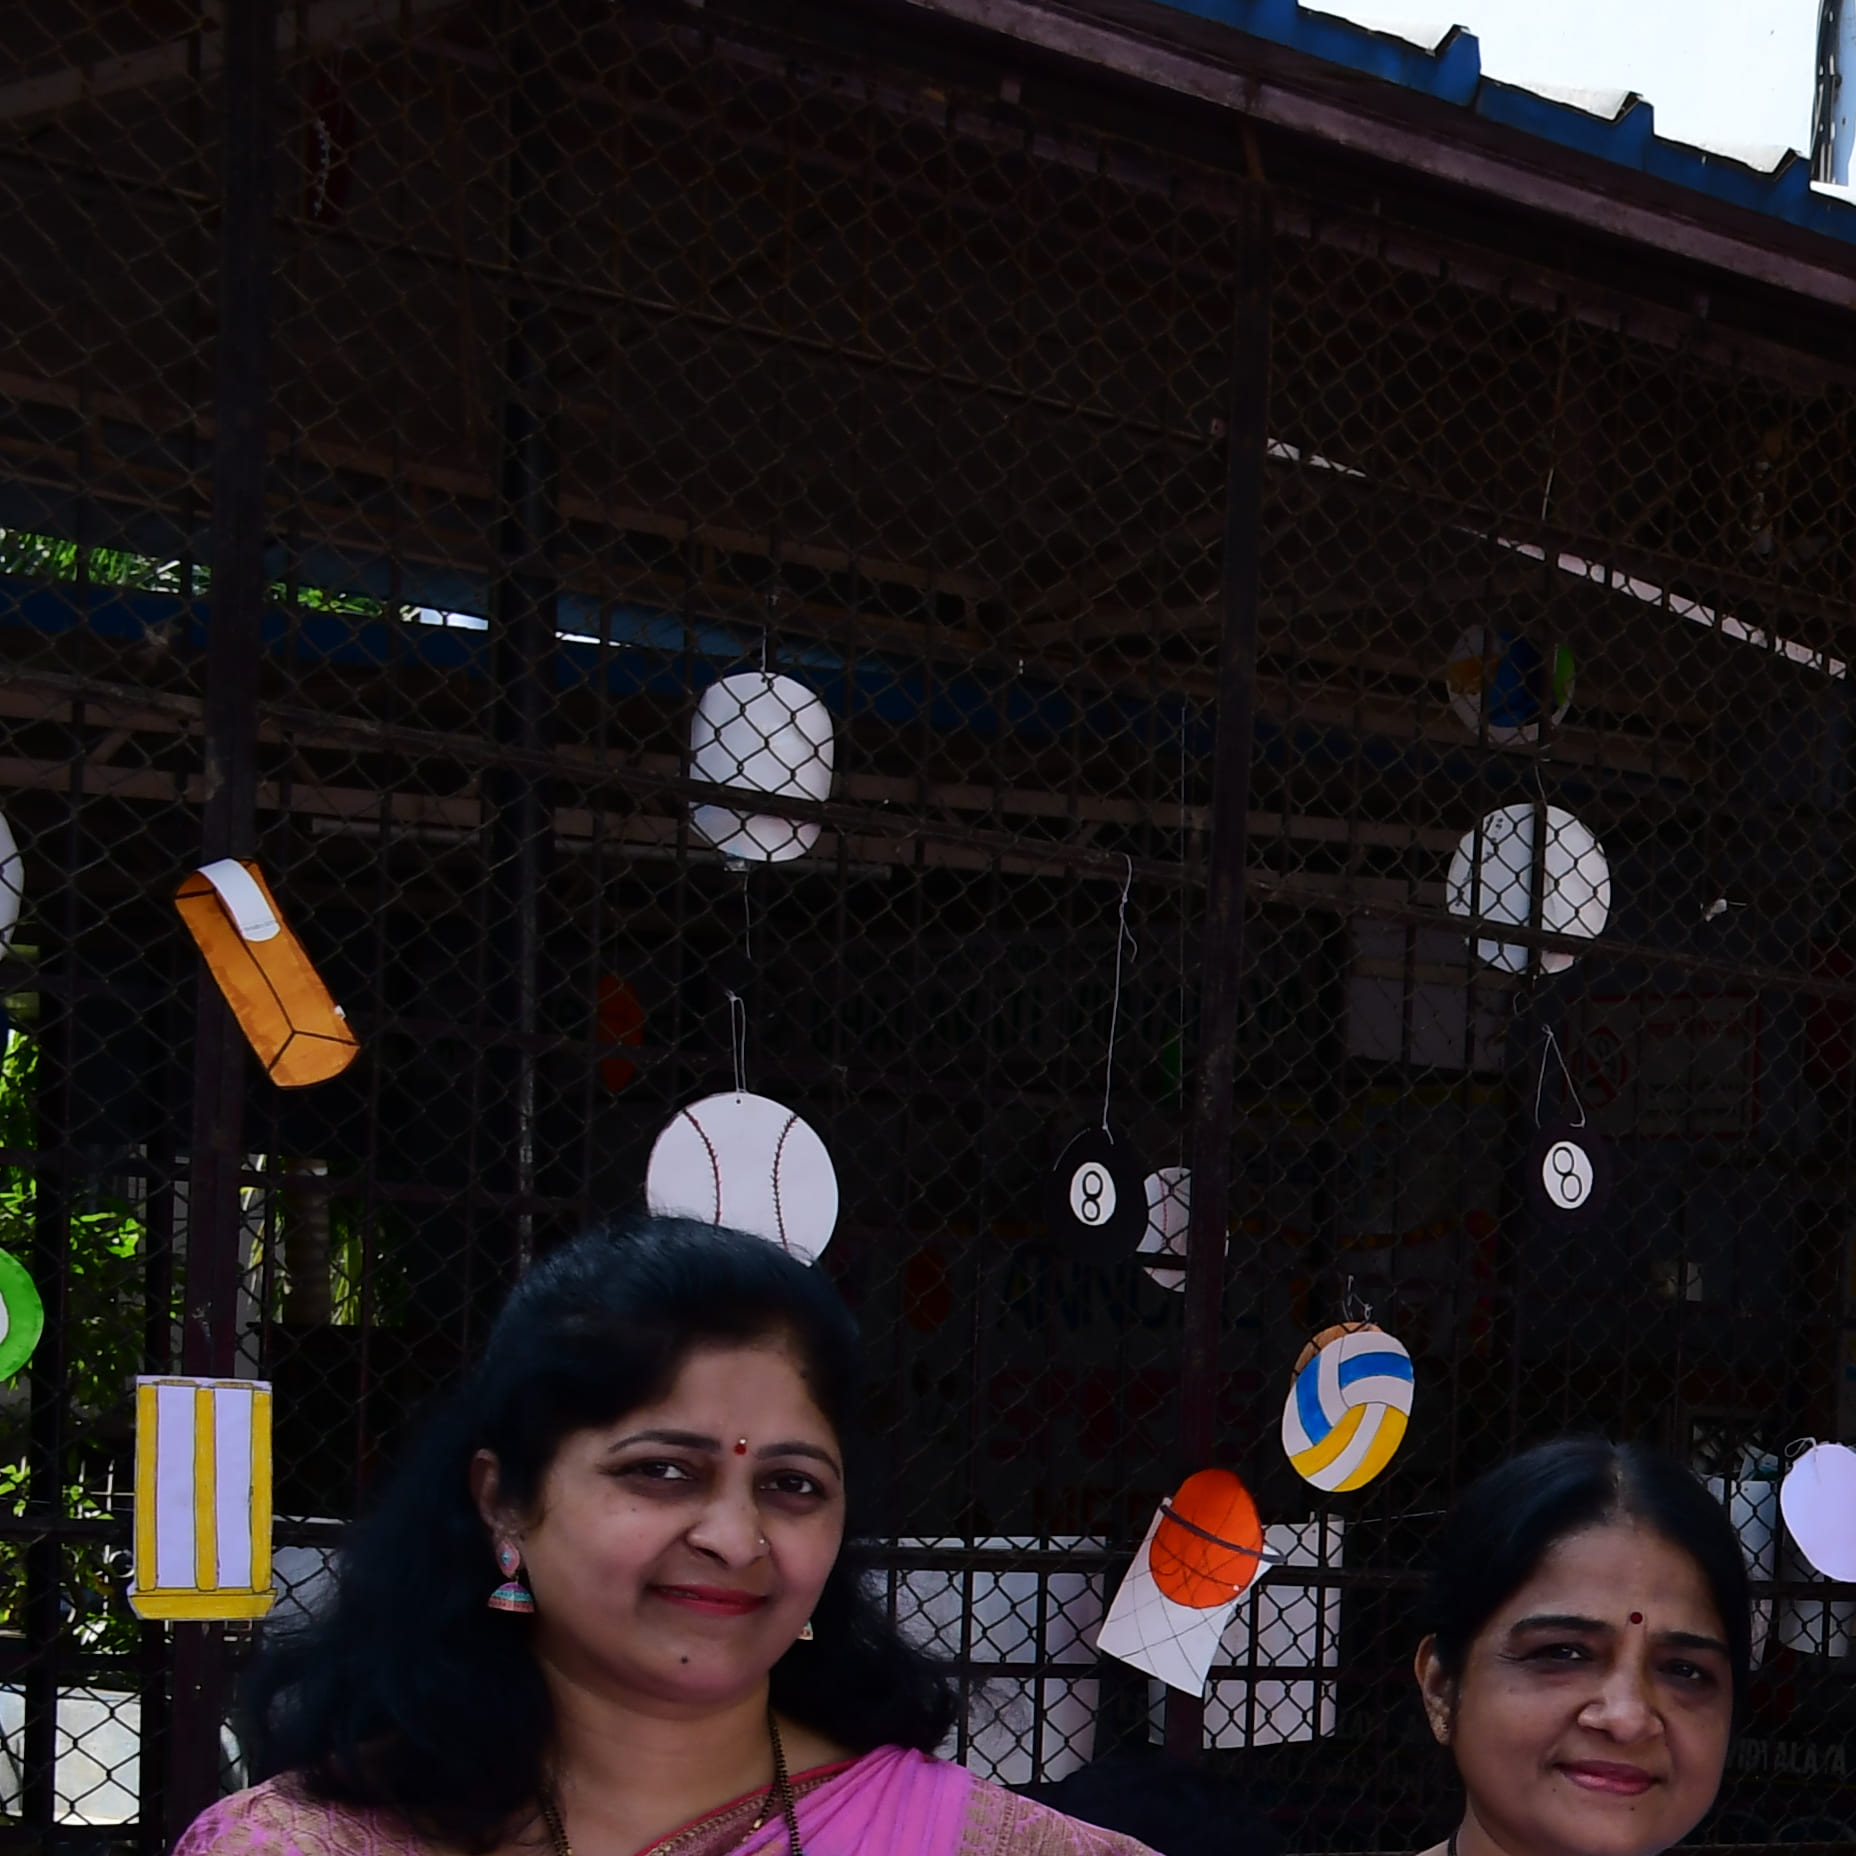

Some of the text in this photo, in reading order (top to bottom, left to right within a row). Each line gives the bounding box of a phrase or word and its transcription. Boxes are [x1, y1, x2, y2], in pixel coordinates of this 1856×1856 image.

[1081, 1170, 1103, 1222] 8
[1552, 1147, 1584, 1203] 8
[997, 1252, 1262, 1331] ANNUL
[987, 1367, 1263, 1464] SPORS
